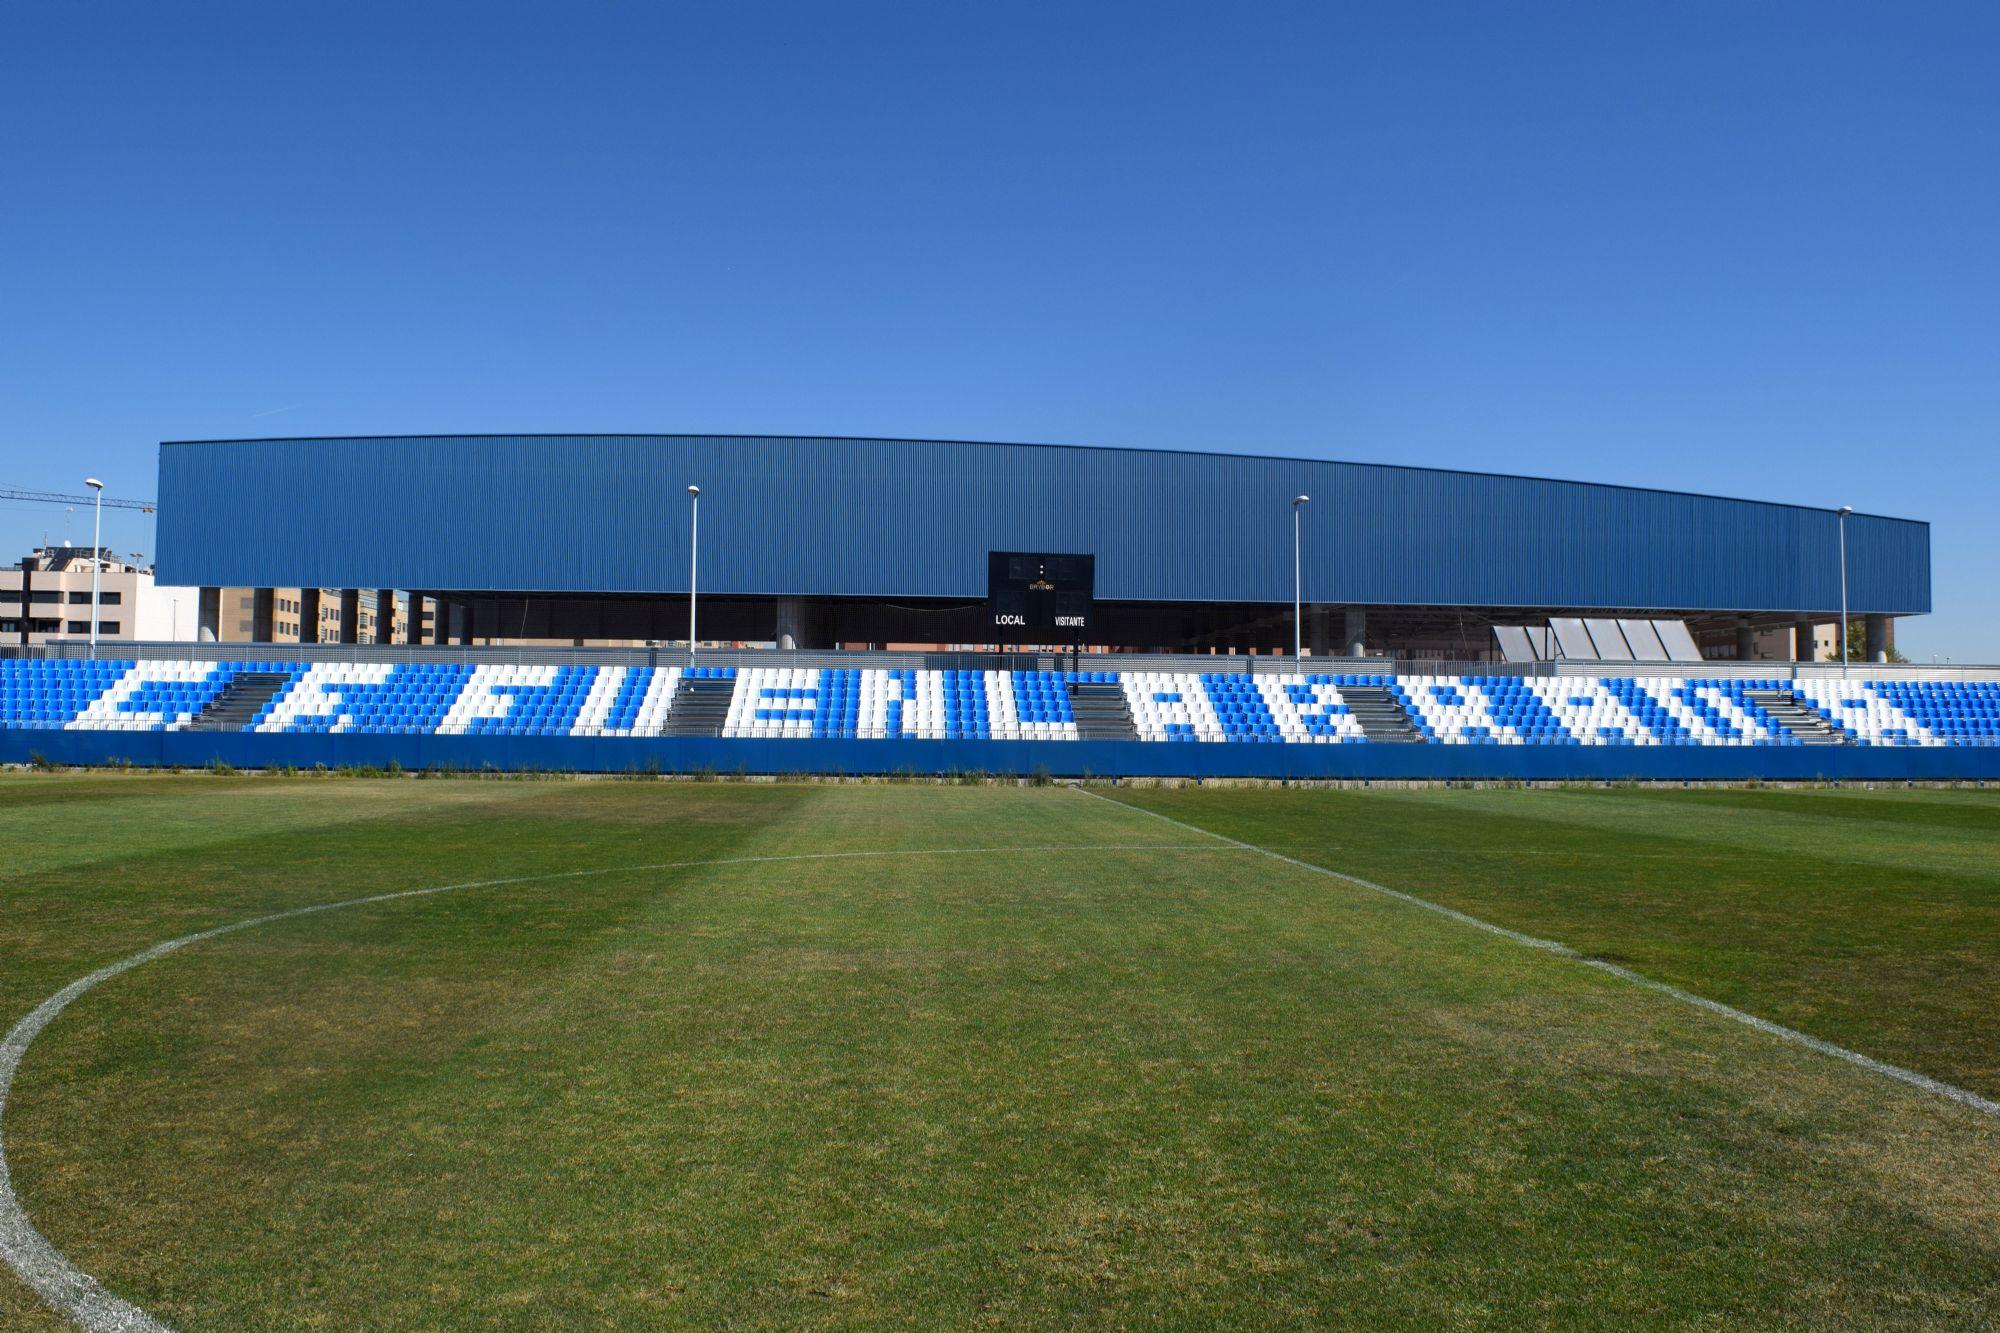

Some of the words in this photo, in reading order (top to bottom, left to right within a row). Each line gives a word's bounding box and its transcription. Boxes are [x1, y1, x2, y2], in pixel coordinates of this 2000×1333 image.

[995, 614, 1026, 625] LOCAL
[1055, 616, 1085, 627] VISITANTE
[434, 665, 1947, 746] FUENLABRADA
